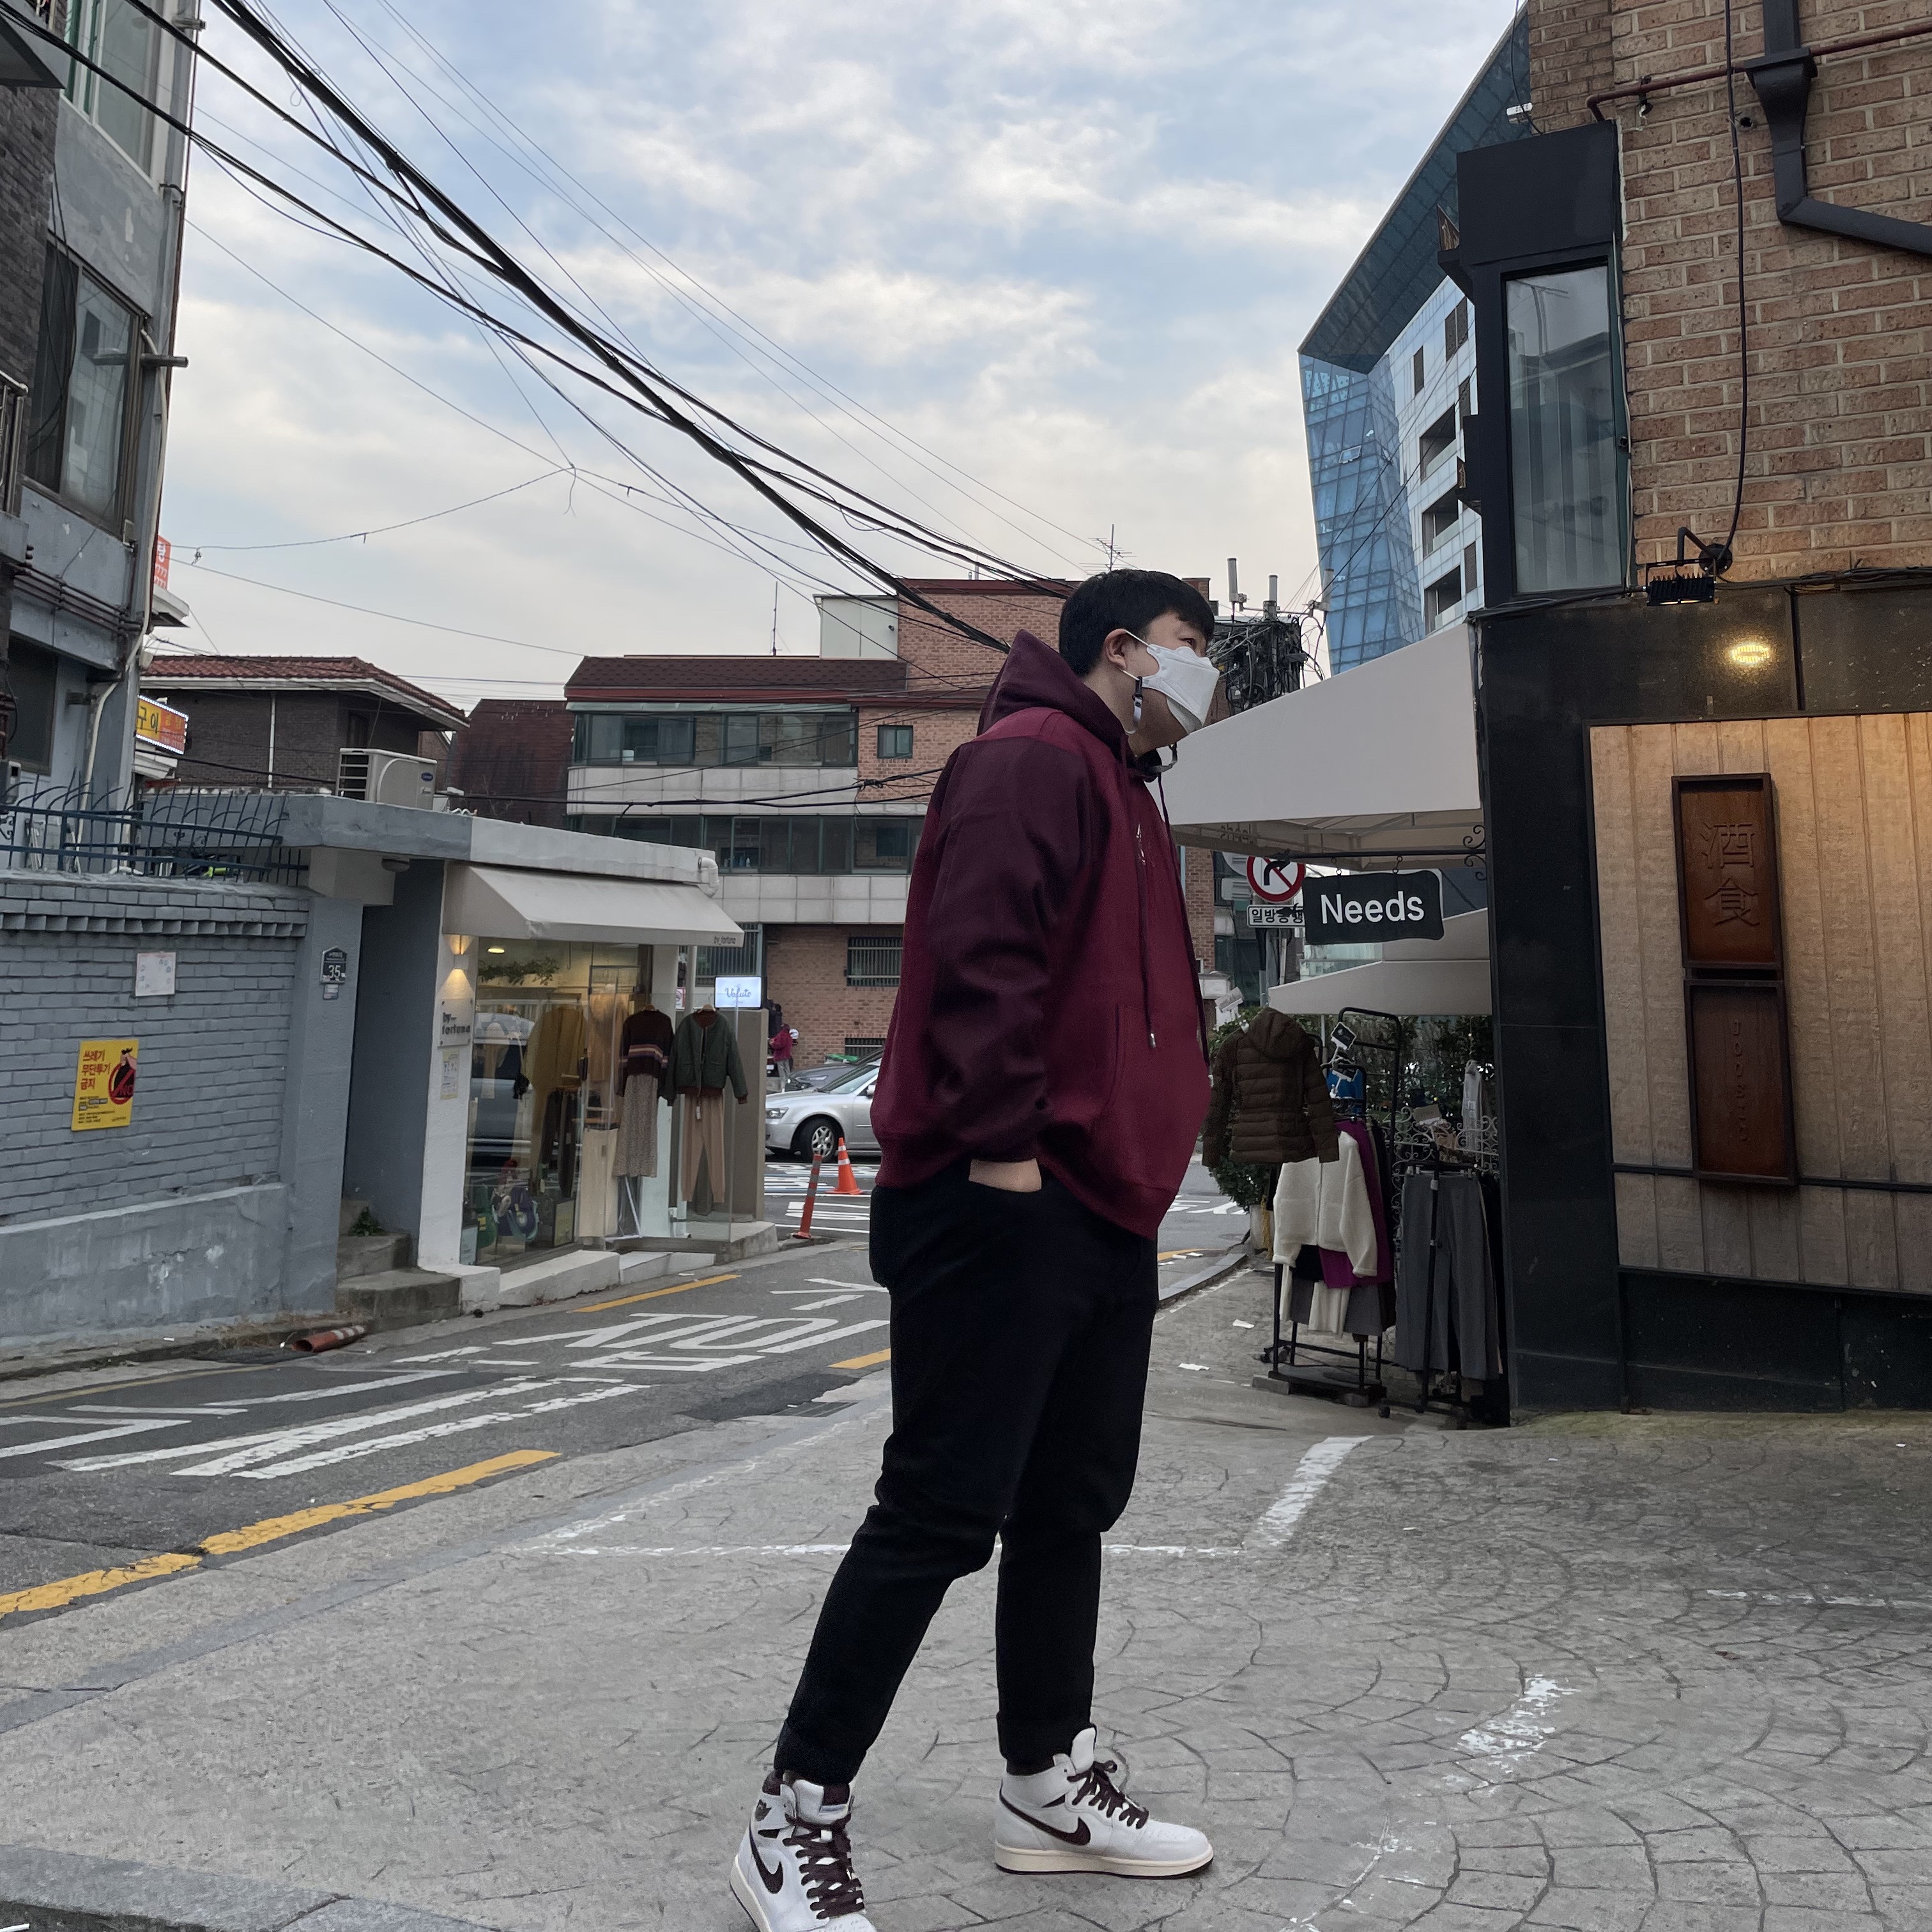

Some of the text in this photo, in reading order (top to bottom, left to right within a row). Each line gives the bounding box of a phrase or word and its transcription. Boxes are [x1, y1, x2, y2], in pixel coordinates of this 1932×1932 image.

[1321, 891, 1425, 924] Needs
[328, 965, 341, 978] 35
[83, 1049, 105, 1061] 쓰레기
[82, 1063, 111, 1076] 무단투기
[81, 1078, 95, 1090] 금지
